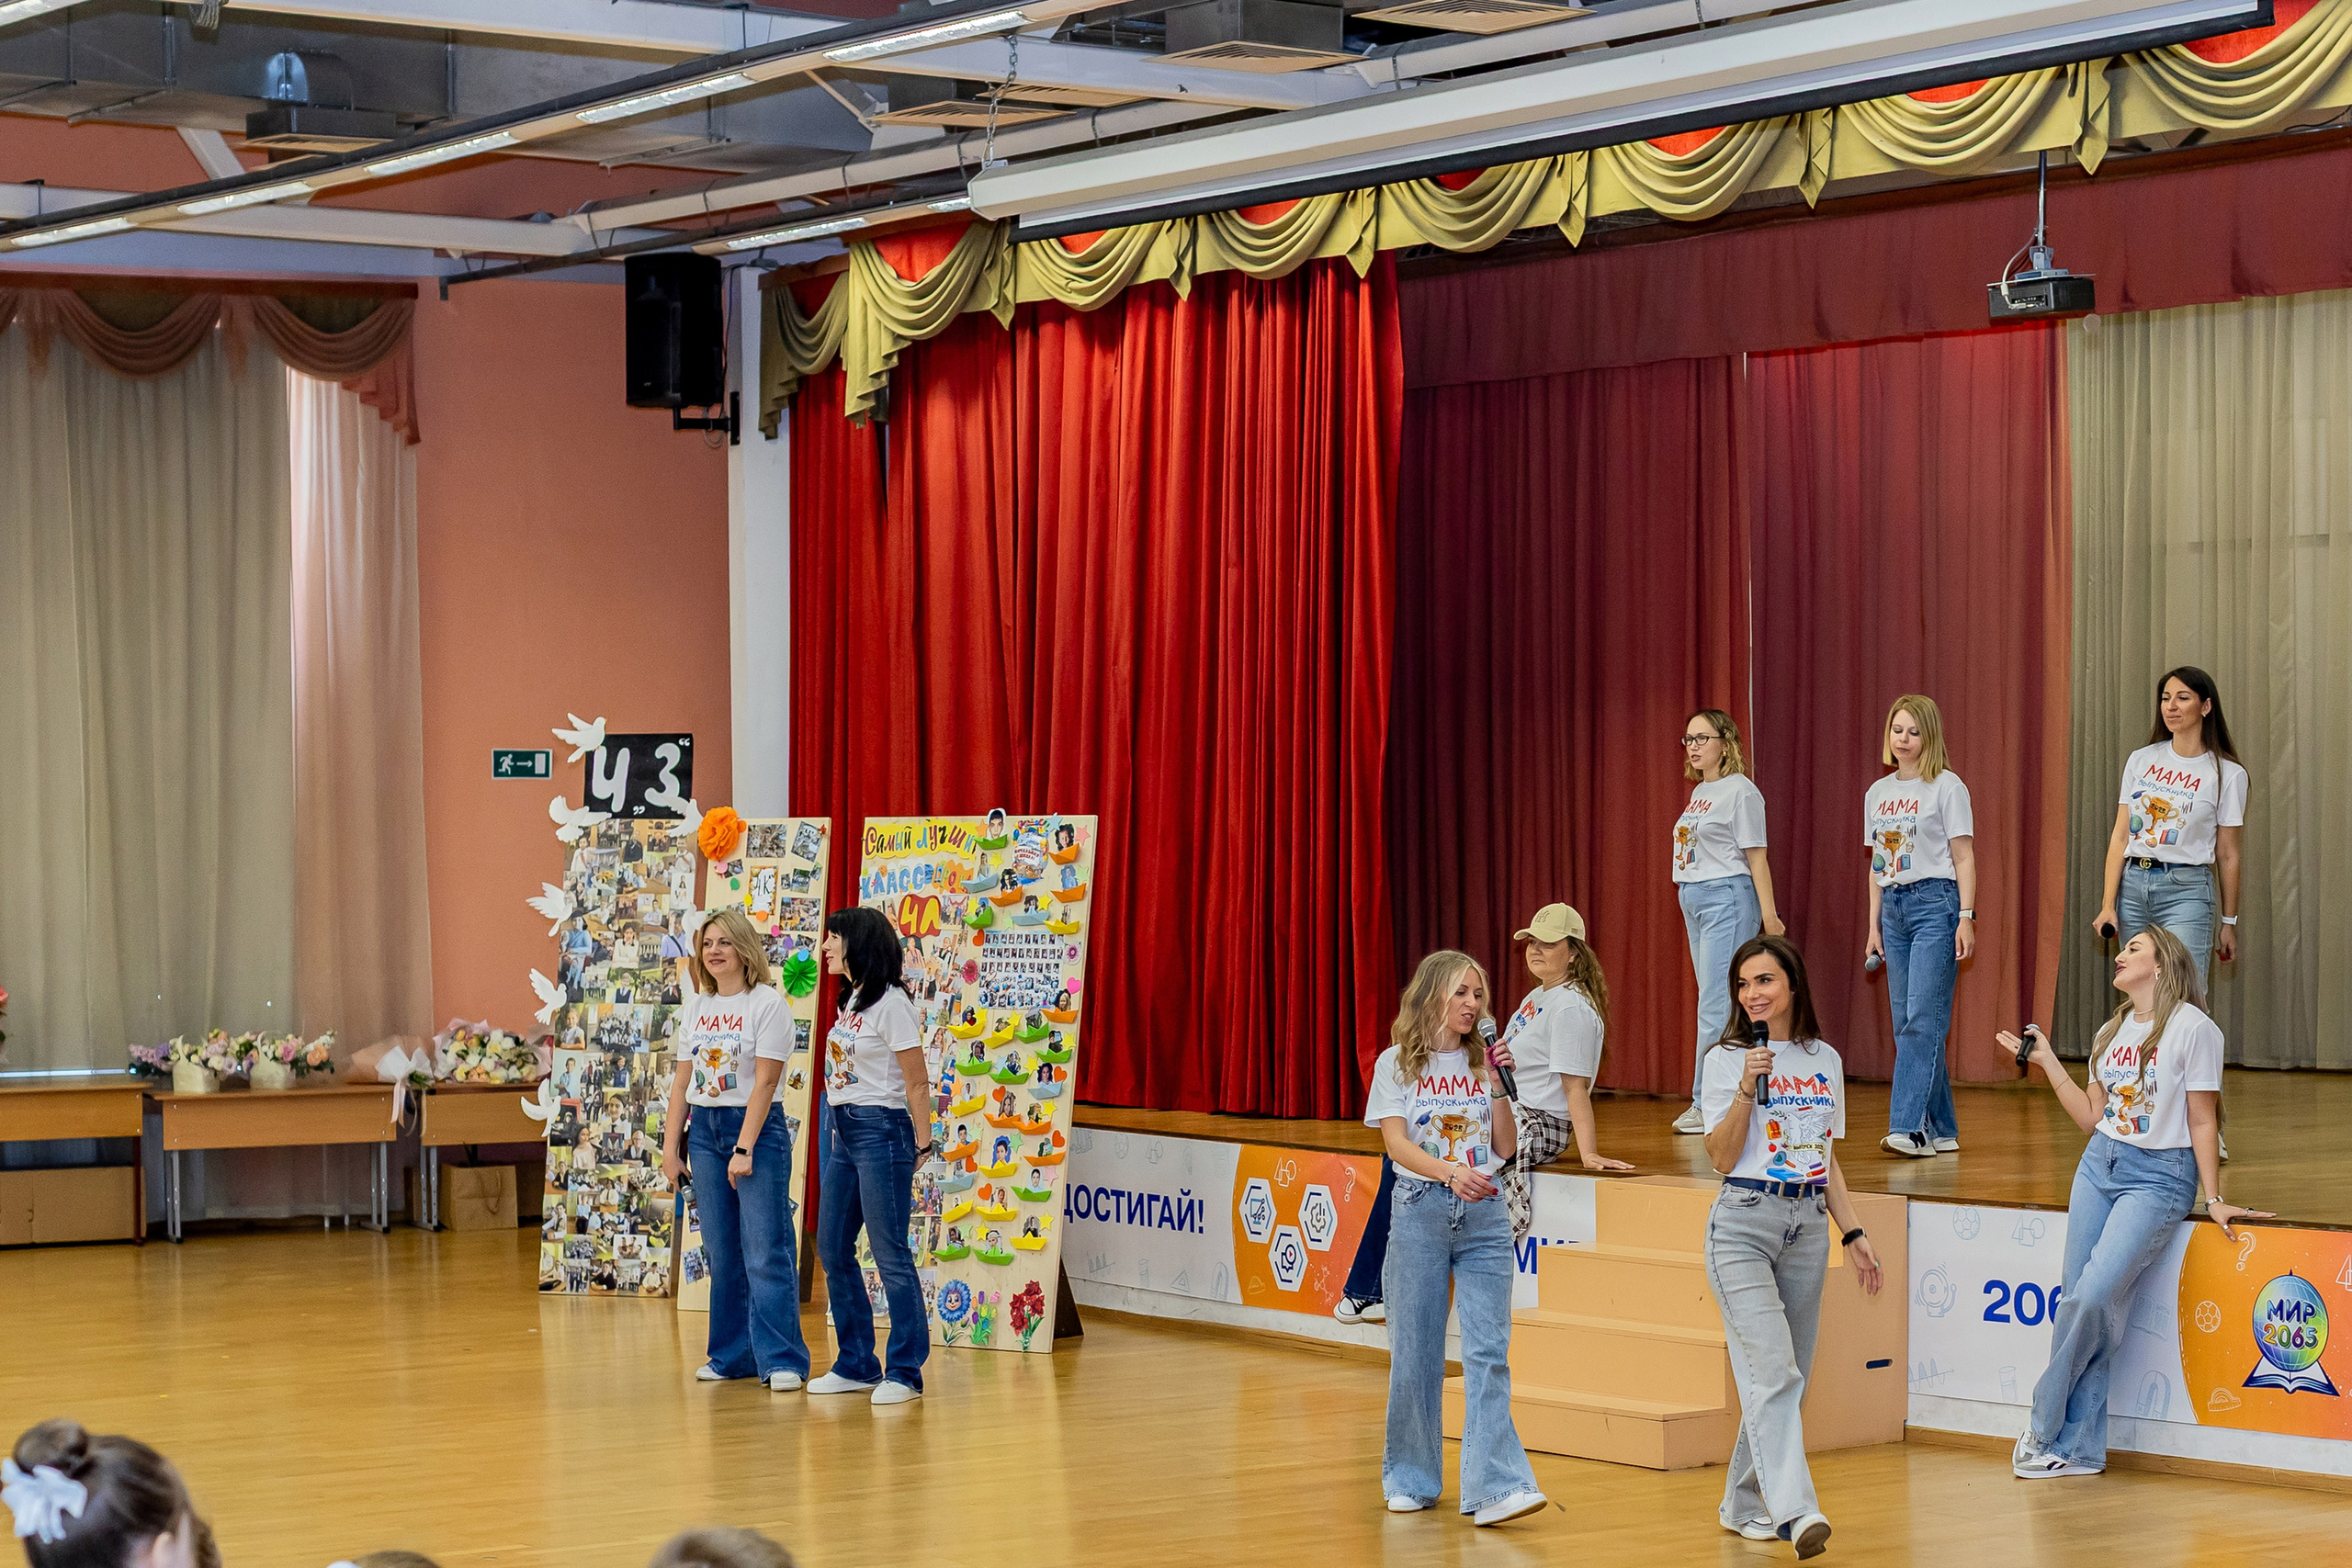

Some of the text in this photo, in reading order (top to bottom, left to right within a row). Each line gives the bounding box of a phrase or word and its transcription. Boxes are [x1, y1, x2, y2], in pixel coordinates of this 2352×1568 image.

[2143, 764, 2201, 792] МАМА
[2137, 779, 2195, 800] выпускника
[1872, 798, 1919, 818] МАМА
[865, 824, 977, 856] Самый лучши
[695, 1013, 743, 1032] МАМА
[692, 1032, 741, 1043] выпусика
[2104, 1067, 2155, 1081] выпуска
[1417, 1074, 1485, 1097] МАМА
[1768, 1074, 1833, 1096] МАМА
[1415, 1096, 1487, 1110] выпускника
[2267, 1299, 2316, 1324] МИР
[2264, 1324, 2318, 1348] 2065
